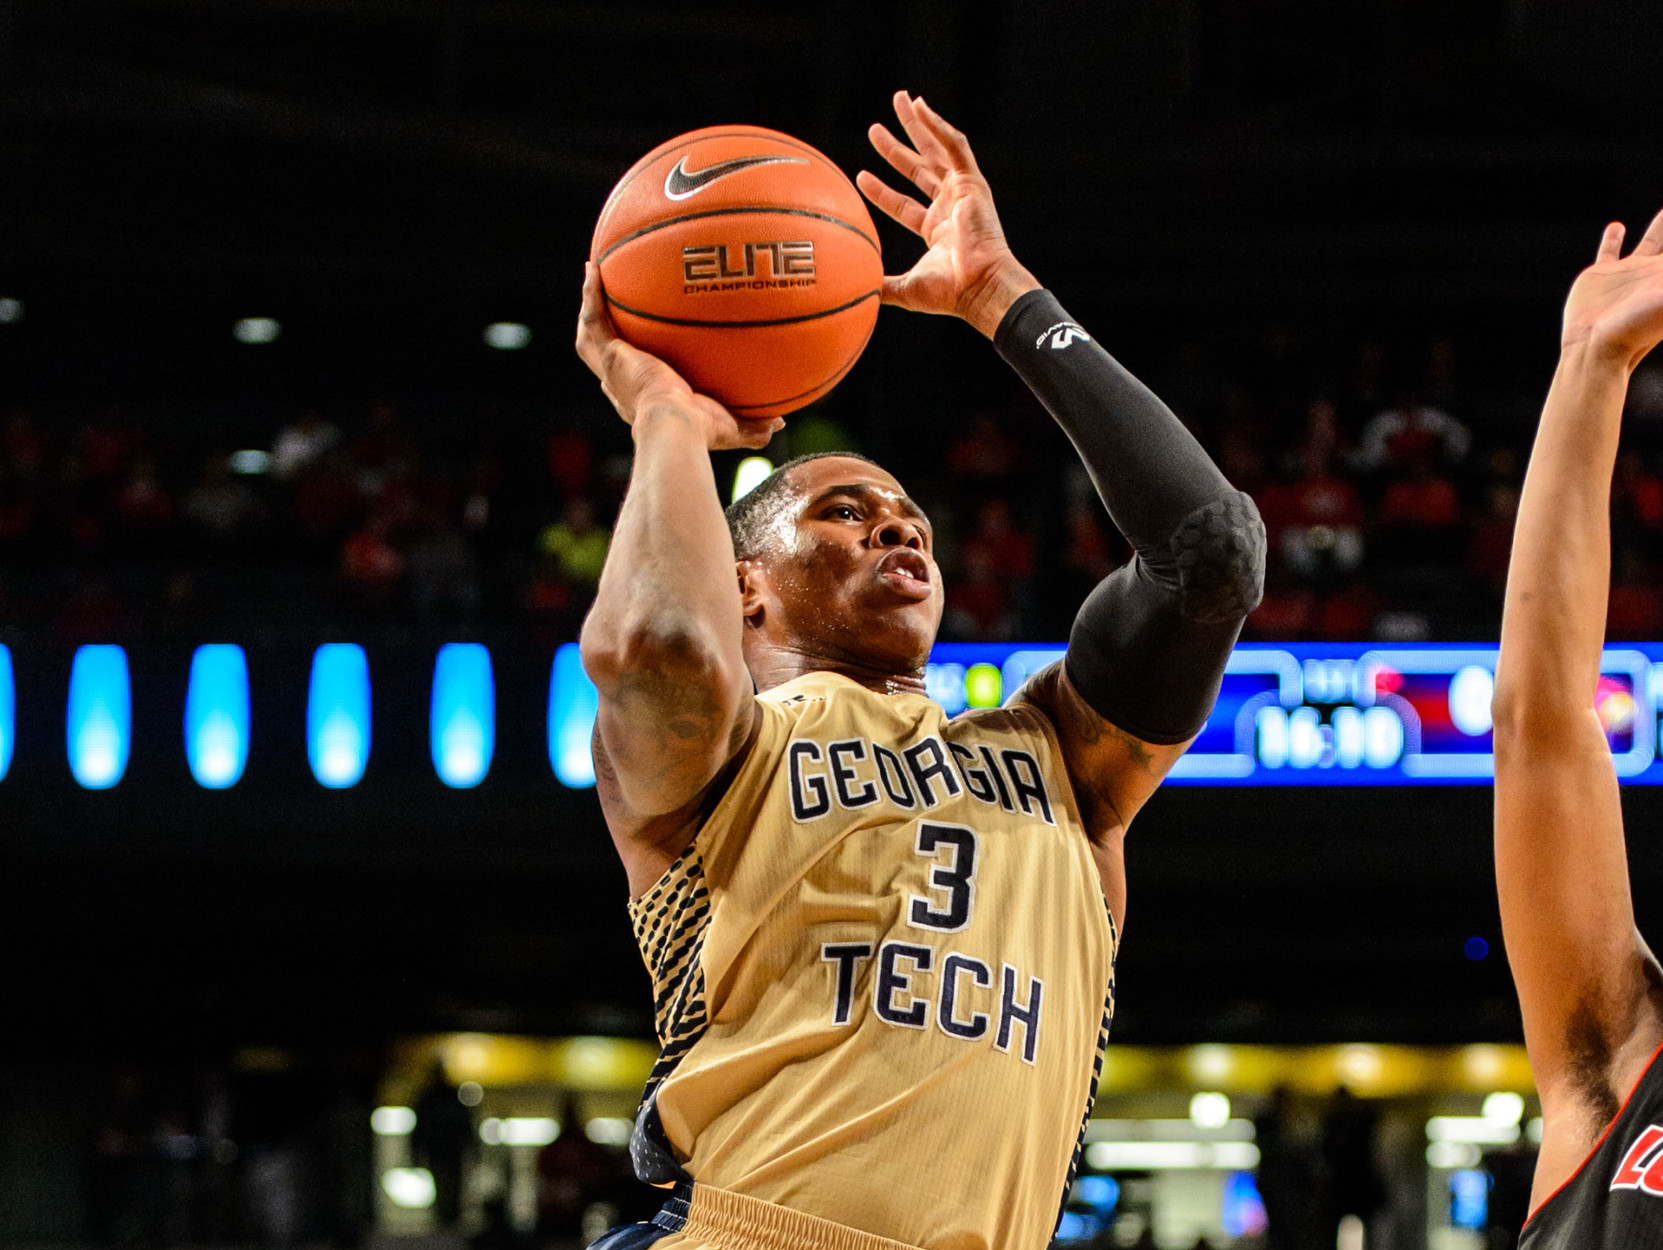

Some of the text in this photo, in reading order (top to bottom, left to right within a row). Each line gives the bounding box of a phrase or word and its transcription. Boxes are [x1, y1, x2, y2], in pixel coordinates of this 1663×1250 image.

[682, 241, 816, 284] ELITE
[683, 279, 817, 295] CHAMPIONSHIP
[787, 734, 1057, 826] GEORGIA
[906, 818, 980, 934] 3
[821, 940, 1044, 1067] TECH
